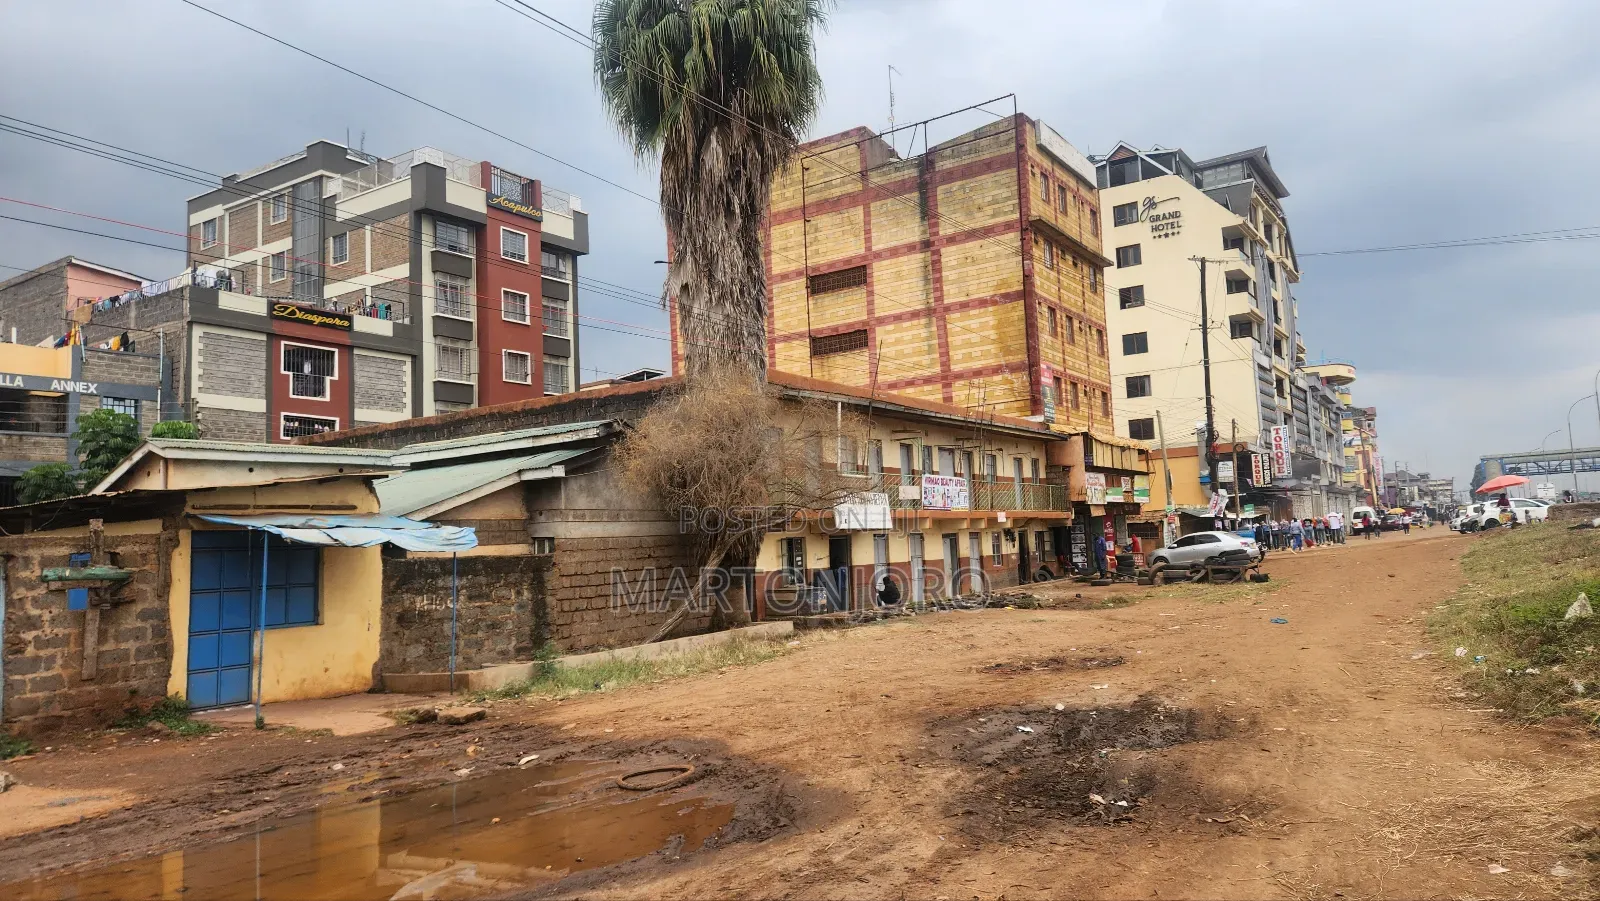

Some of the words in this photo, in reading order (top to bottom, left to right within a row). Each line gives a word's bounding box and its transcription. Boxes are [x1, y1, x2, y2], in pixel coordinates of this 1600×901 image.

[489, 196, 542, 217] Acapulco
[1149, 211, 1181, 222] GRAND
[1151, 221, 1182, 232] HOTEL
[272, 304, 350, 327] Diaspora
[51, 380, 97, 394] ANNEX
[1273, 428, 1286, 474] TORQUE
